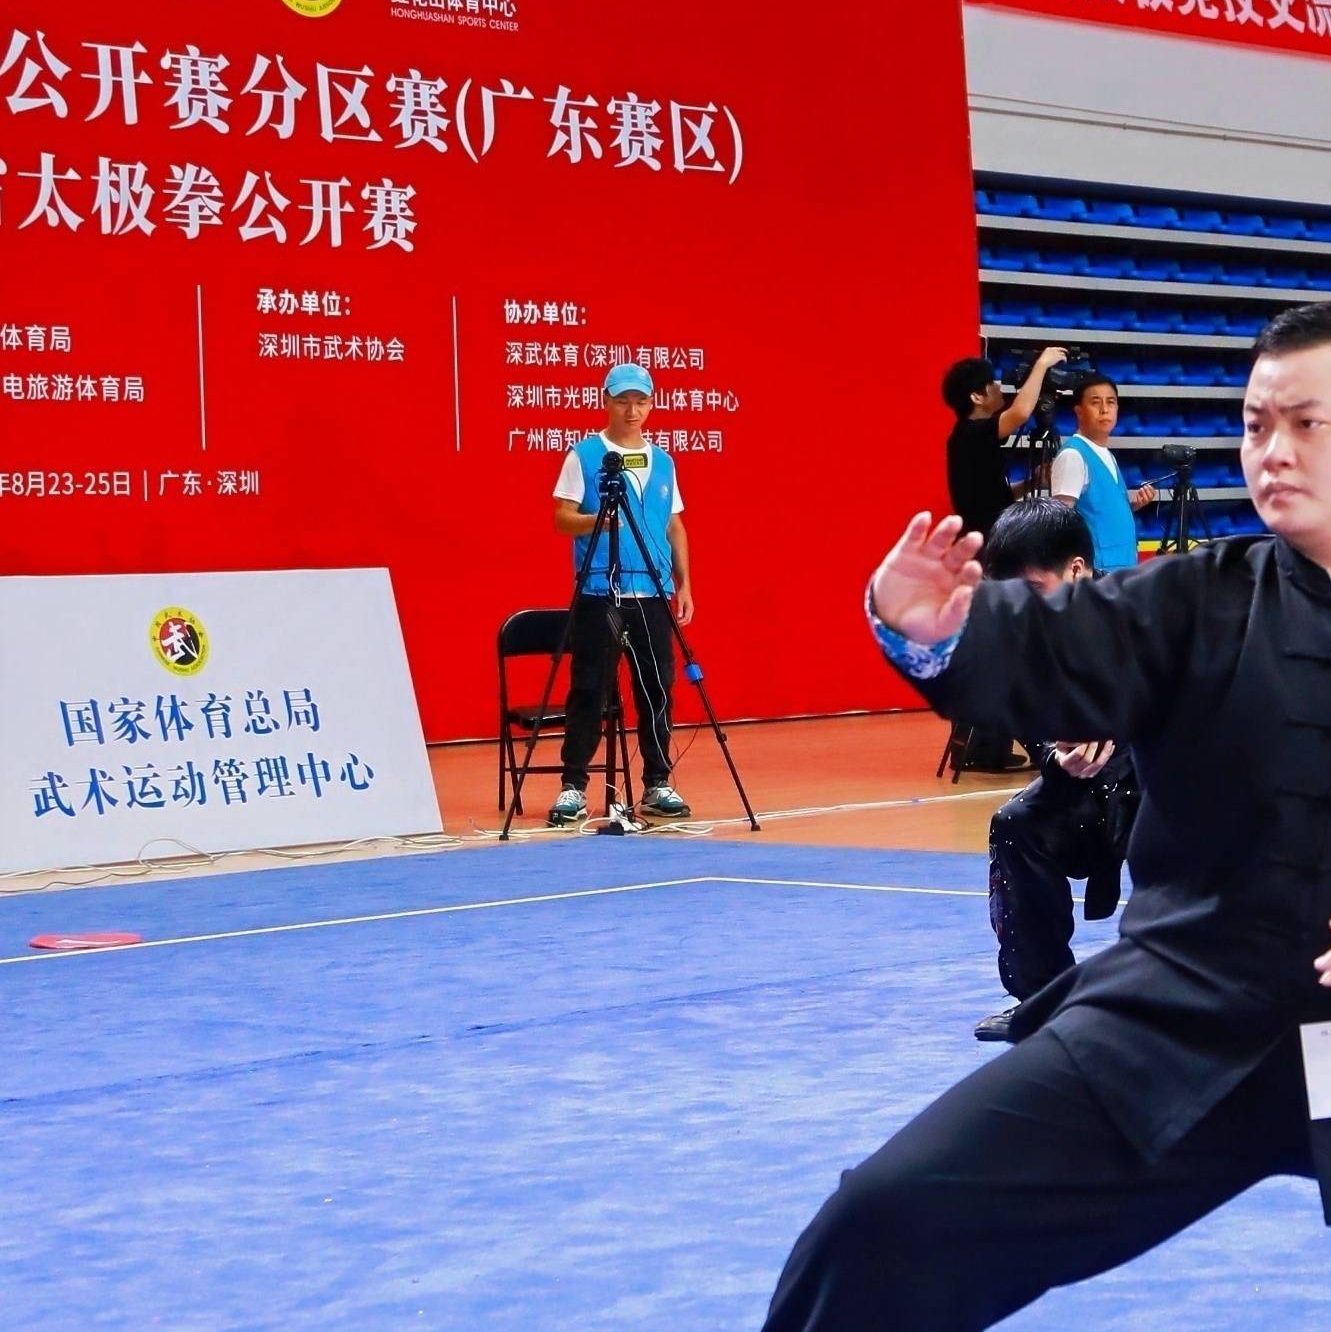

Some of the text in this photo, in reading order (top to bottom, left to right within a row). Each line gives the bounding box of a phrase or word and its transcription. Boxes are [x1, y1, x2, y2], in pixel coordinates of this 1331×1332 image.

[391, 8, 519, 32] HONGHUASHAN SPORTS CENTER
[0, 29, 743, 185] 公开赛分区赛(广东赛区)
[0, 152, 418, 252] 太极拳公开赛
[257, 288, 351, 317] 承办单位：
[504, 299, 587, 327] 协办单位：
[0, 323, 71, 353] 体育局
[258, 332, 405, 362] 深圳市武术协会
[2, 373, 145, 402] 电旅游体育局
[506, 384, 740, 412] 深圳市光明山体育中心
[60, 687, 321, 747] 国家体育总局
[29, 751, 375, 818] 武术运动管理中心
